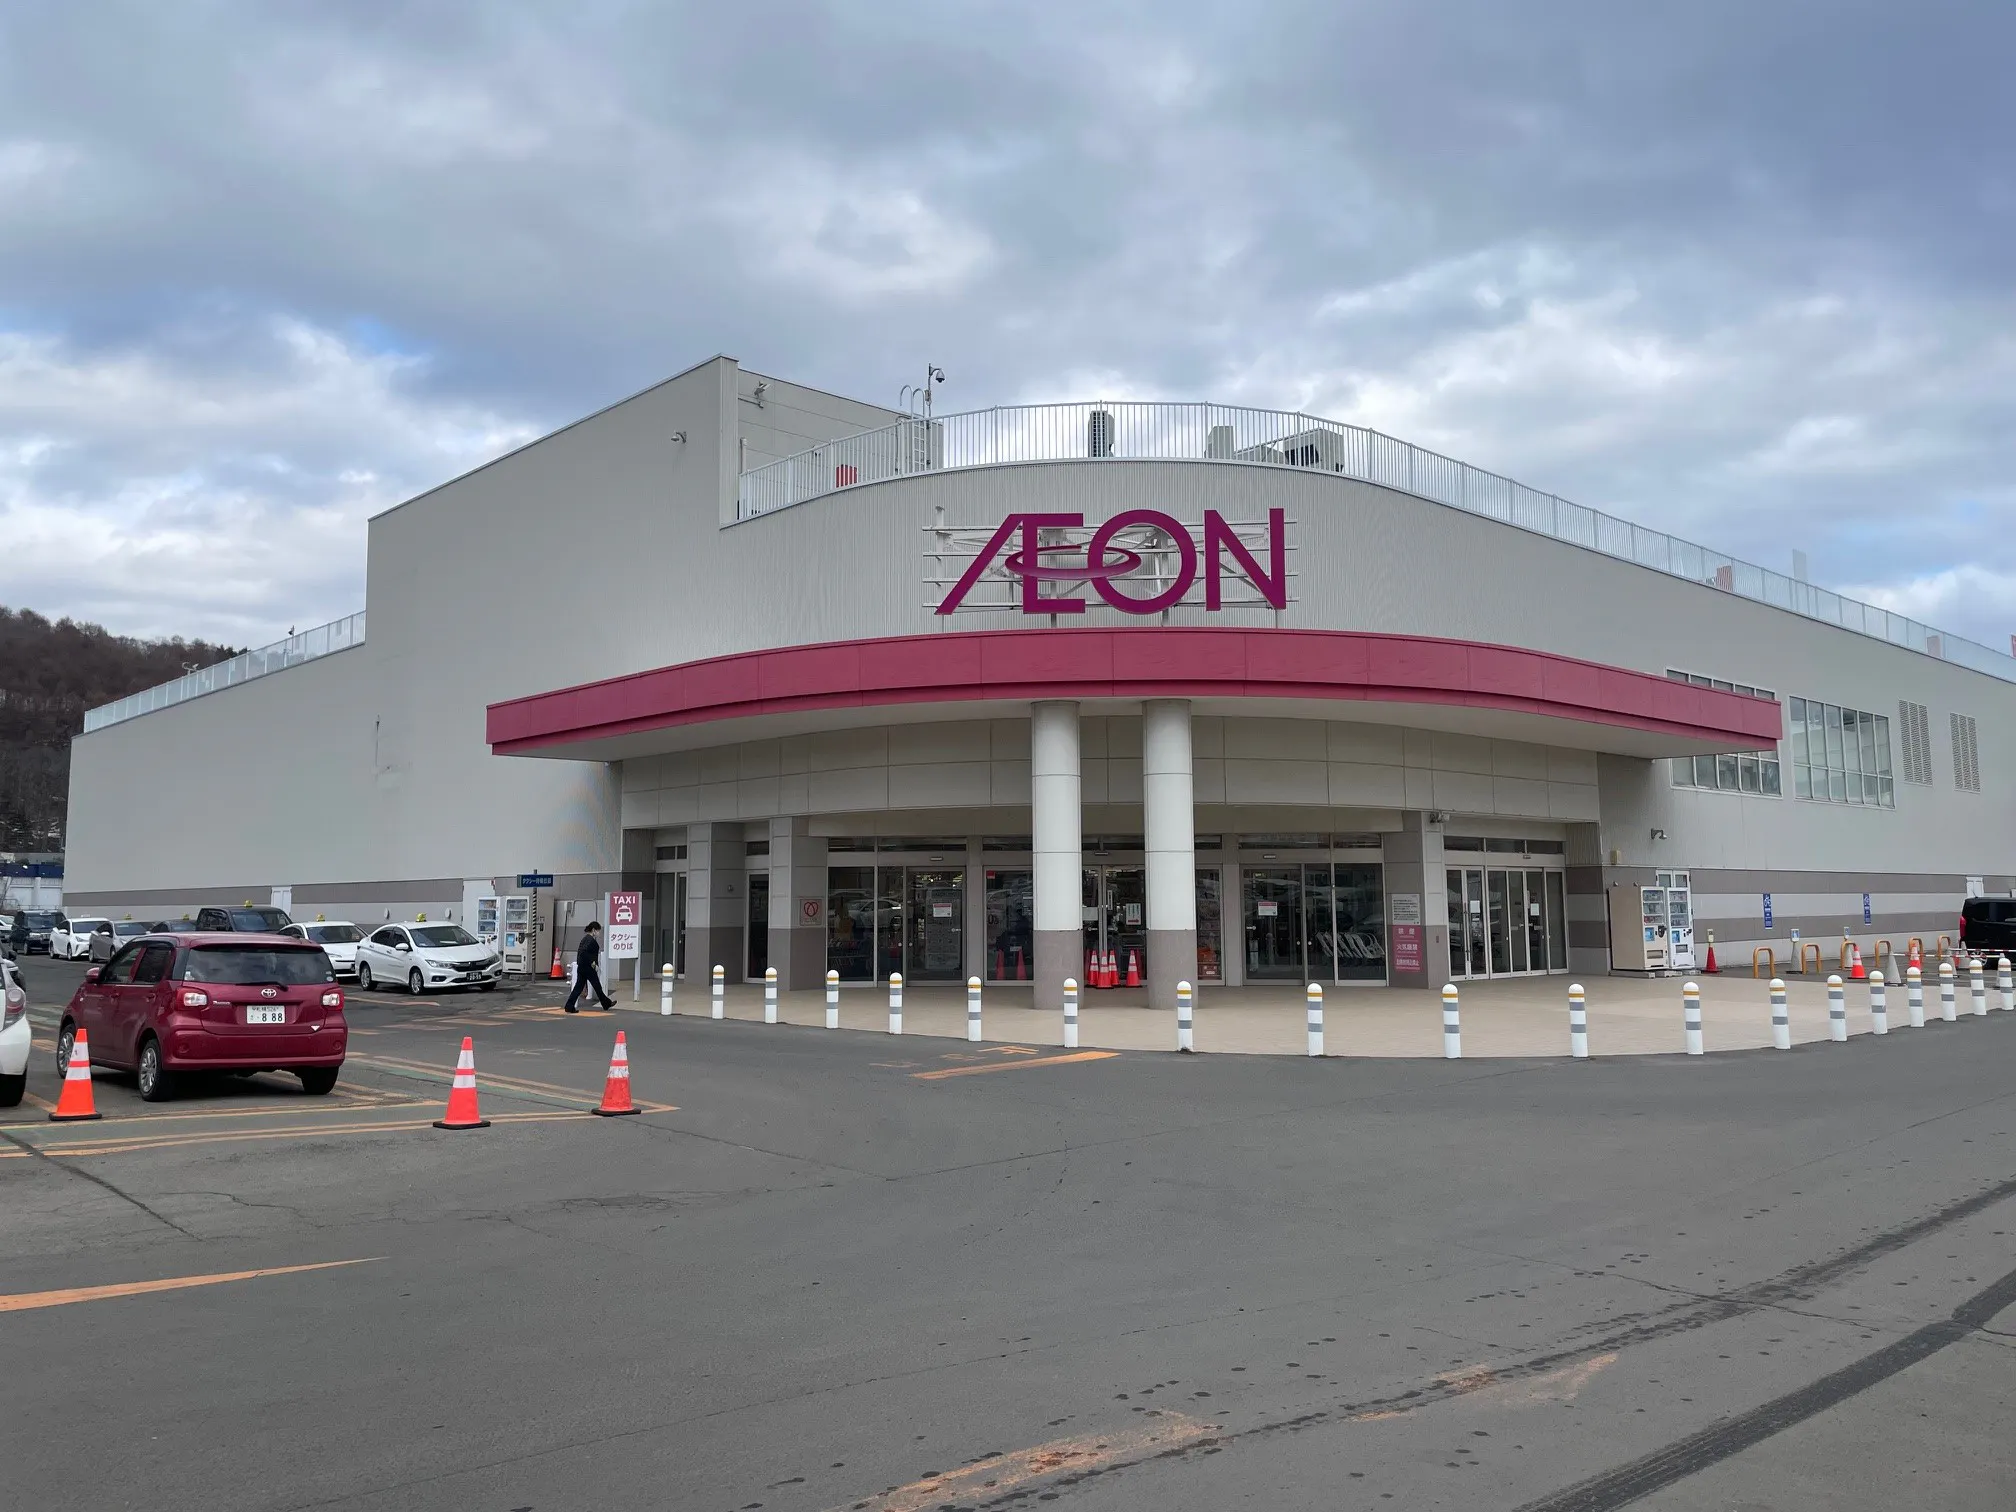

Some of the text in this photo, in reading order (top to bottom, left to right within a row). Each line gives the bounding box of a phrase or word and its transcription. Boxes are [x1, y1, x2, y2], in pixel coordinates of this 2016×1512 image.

[613, 896, 635, 904] TAXI
[611, 933, 637, 941] タクシー
